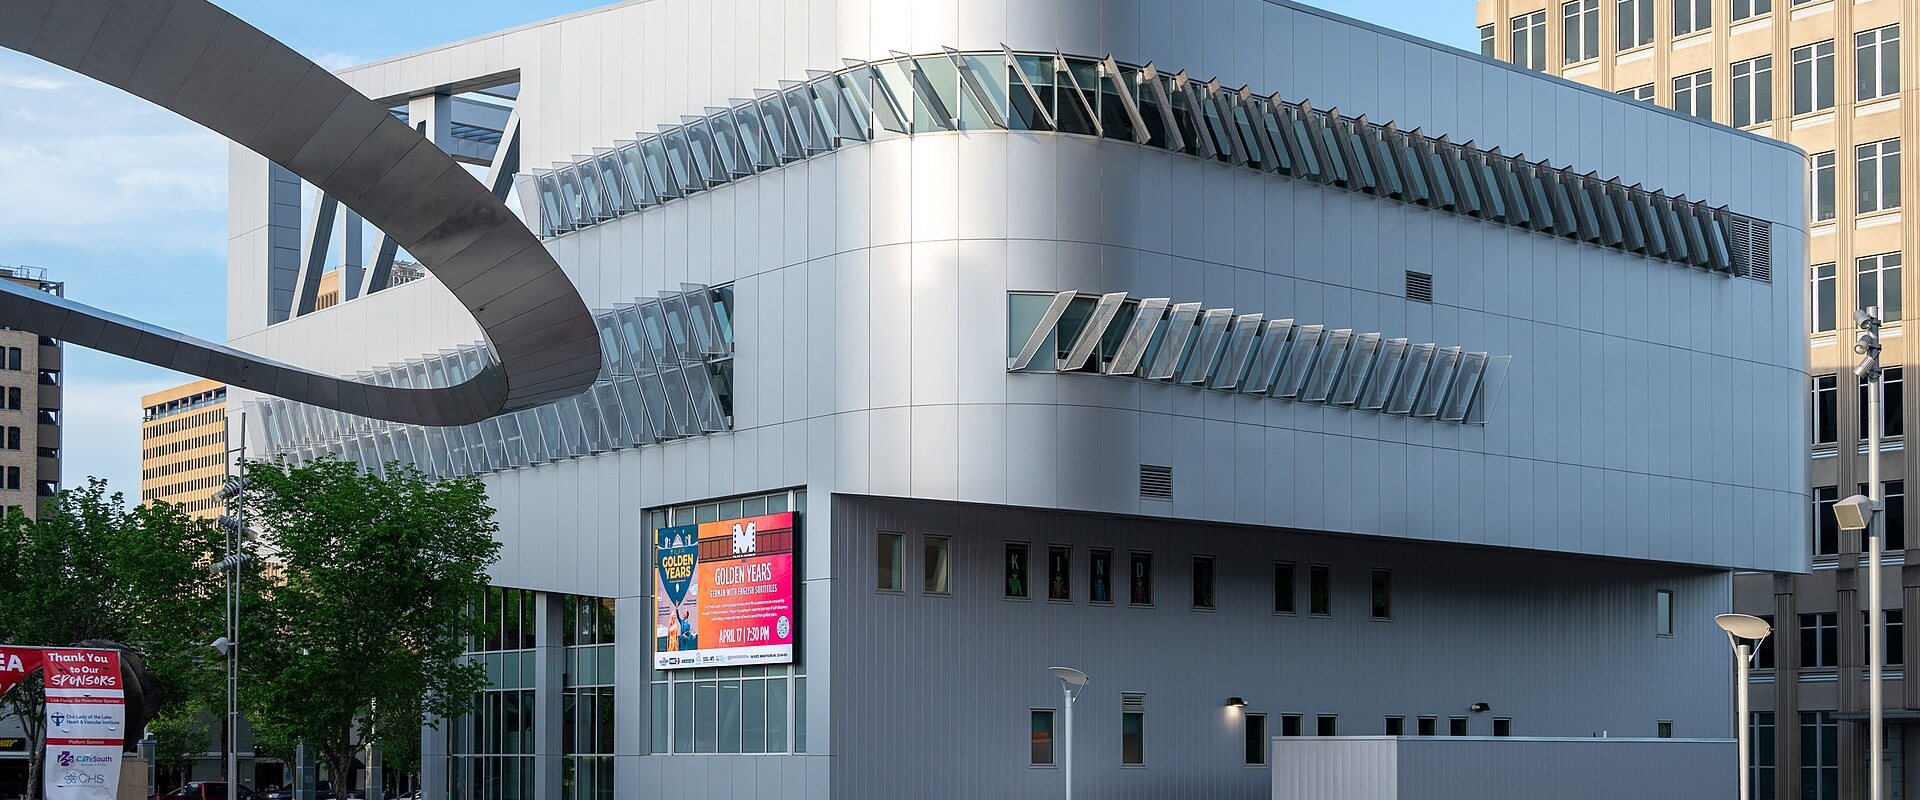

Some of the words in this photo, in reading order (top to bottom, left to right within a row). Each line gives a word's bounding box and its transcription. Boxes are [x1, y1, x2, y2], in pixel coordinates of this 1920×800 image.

[733, 521, 756, 554] M
[662, 554, 693, 568] GOLDEN
[664, 566, 690, 579] YEARS
[715, 564, 744, 585] GOLDEN
[746, 562, 772, 582] YEARS
[710, 589, 726, 598] GERMAN
[738, 586, 754, 596] ENGLISH
[755, 584, 778, 594] SUBTITLES
[718, 628, 735, 643] APRIL
[736, 627, 742, 642] 17
[746, 626, 759, 642] 7:30
[760, 625, 770, 641] PM
[48, 652, 85, 662] Thank
[86, 653, 109, 663] You
[81, 665, 99, 673] Our
[51, 674, 116, 687] SPONSORS
[76, 755, 113, 763] CareSouth
[78, 773, 105, 784] CHS
